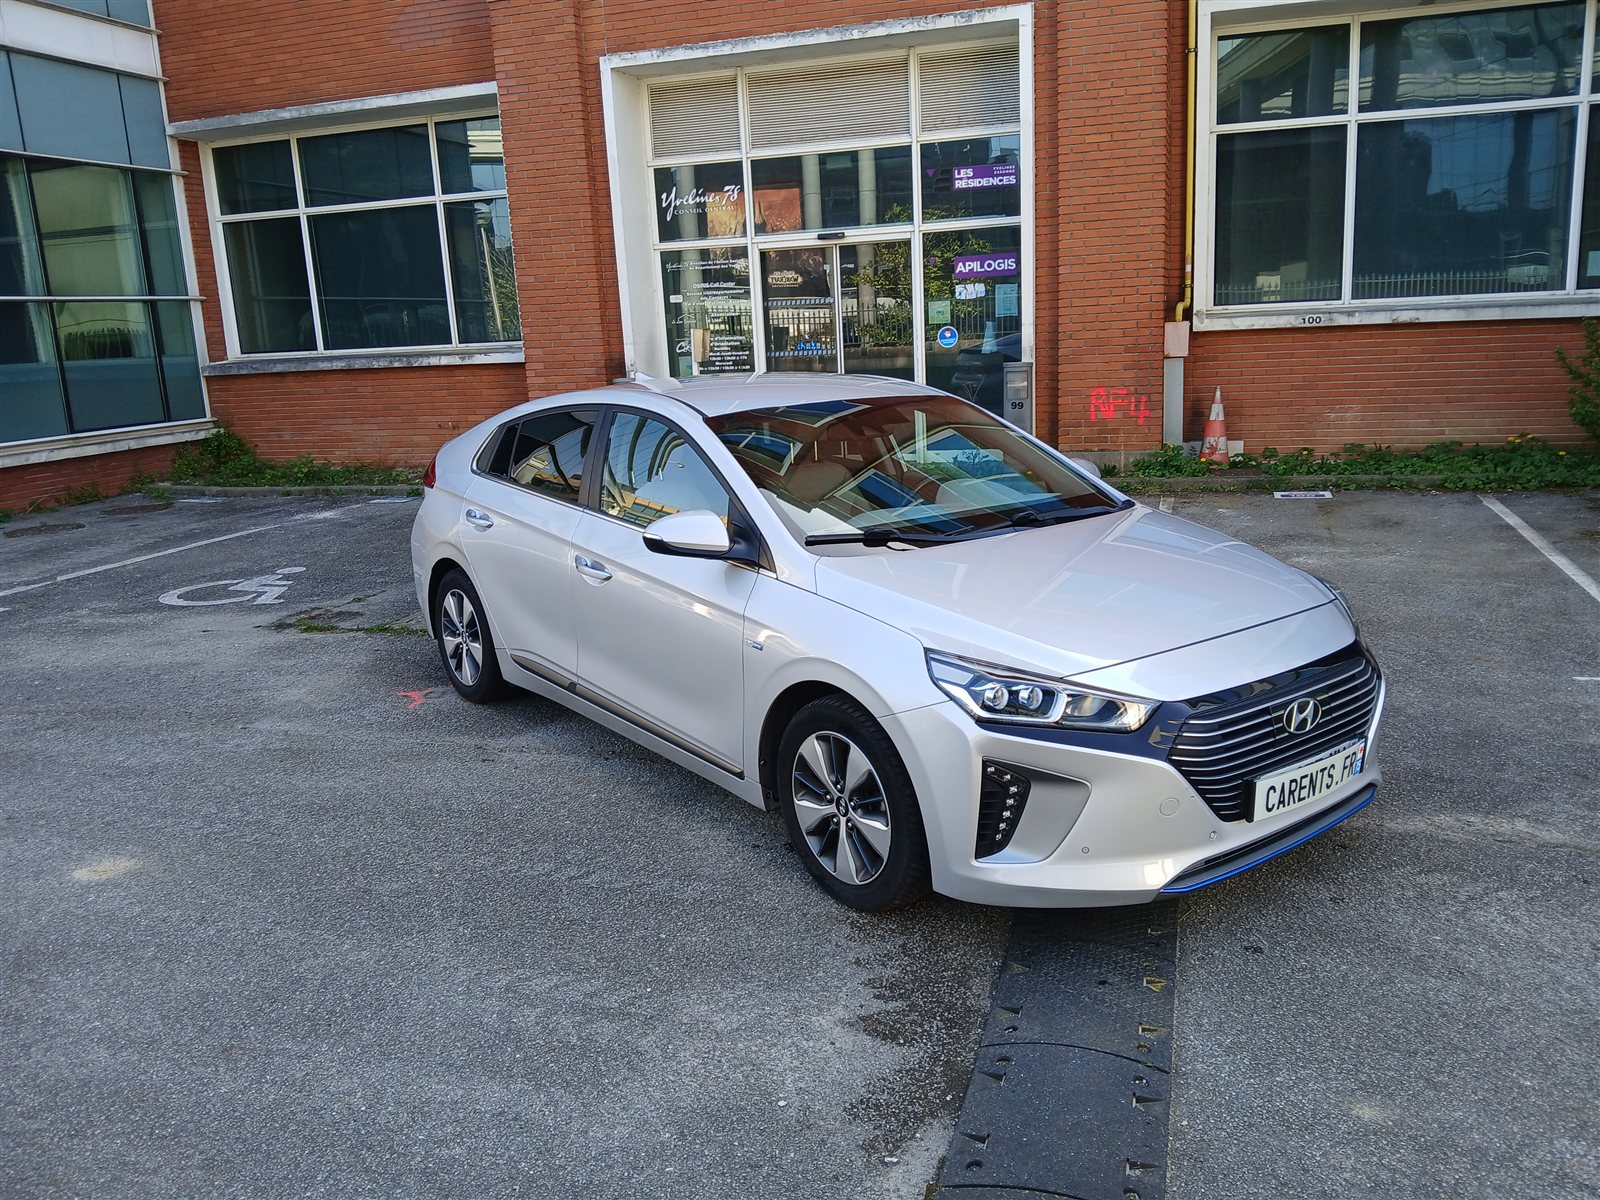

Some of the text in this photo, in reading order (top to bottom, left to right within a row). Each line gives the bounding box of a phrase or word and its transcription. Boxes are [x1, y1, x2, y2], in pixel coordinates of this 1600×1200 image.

[955, 169, 973, 178] LES
[955, 175, 1016, 188] RÉSIDENCES
[661, 185, 741, 222] Yvelines 78
[956, 259, 1016, 273] APILOGIS
[1301, 316, 1321, 324] 100
[1265, 751, 1357, 813] CARENTS.FR
